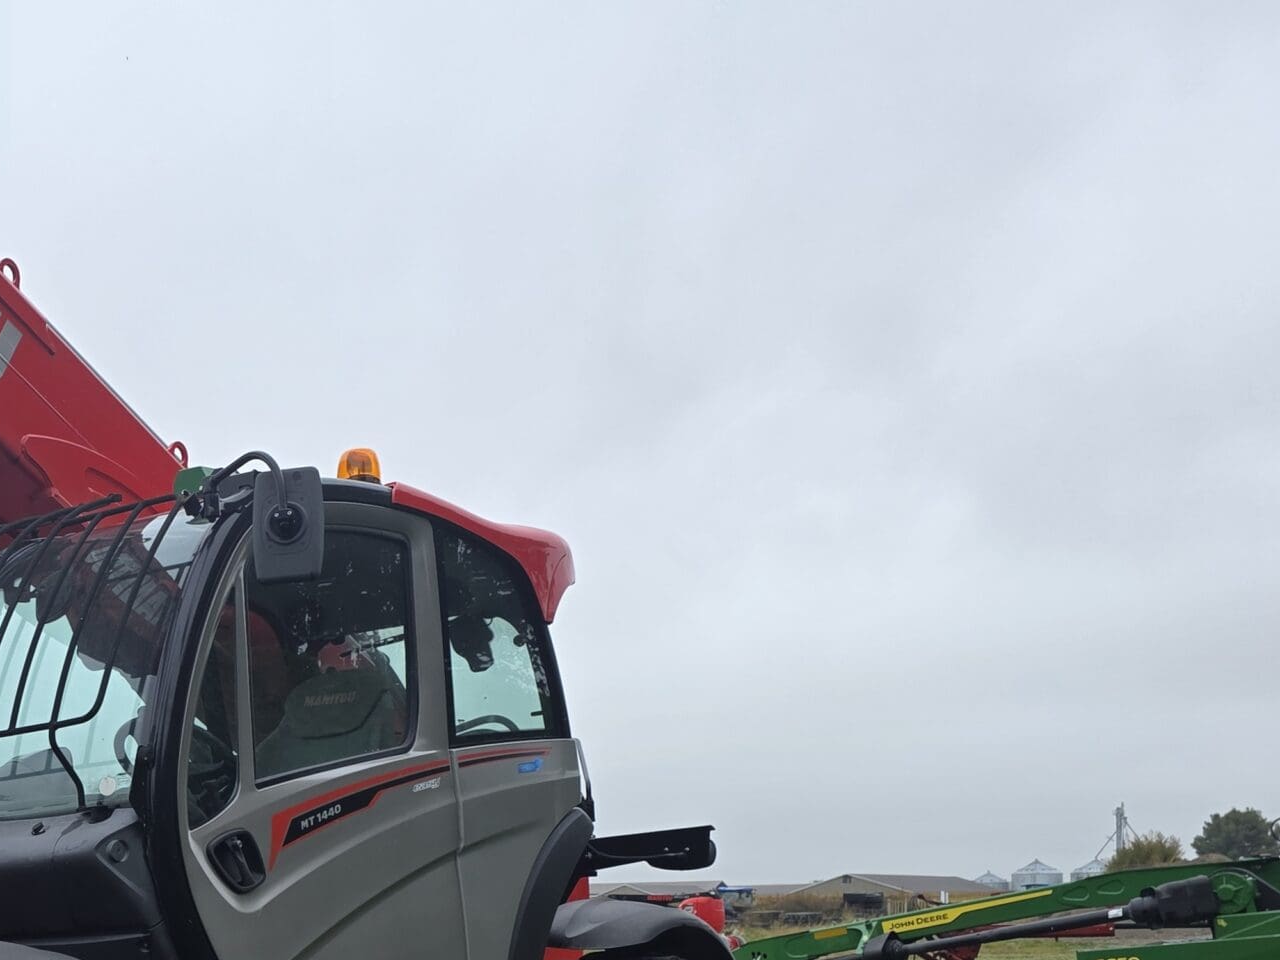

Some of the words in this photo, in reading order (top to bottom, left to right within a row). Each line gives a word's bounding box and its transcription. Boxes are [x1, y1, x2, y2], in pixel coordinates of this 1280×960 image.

[301, 816, 315, 830] MT
[317, 804, 342, 822] 1440
[889, 920, 915, 930] JOHN
[916, 913, 949, 925] DEERE
